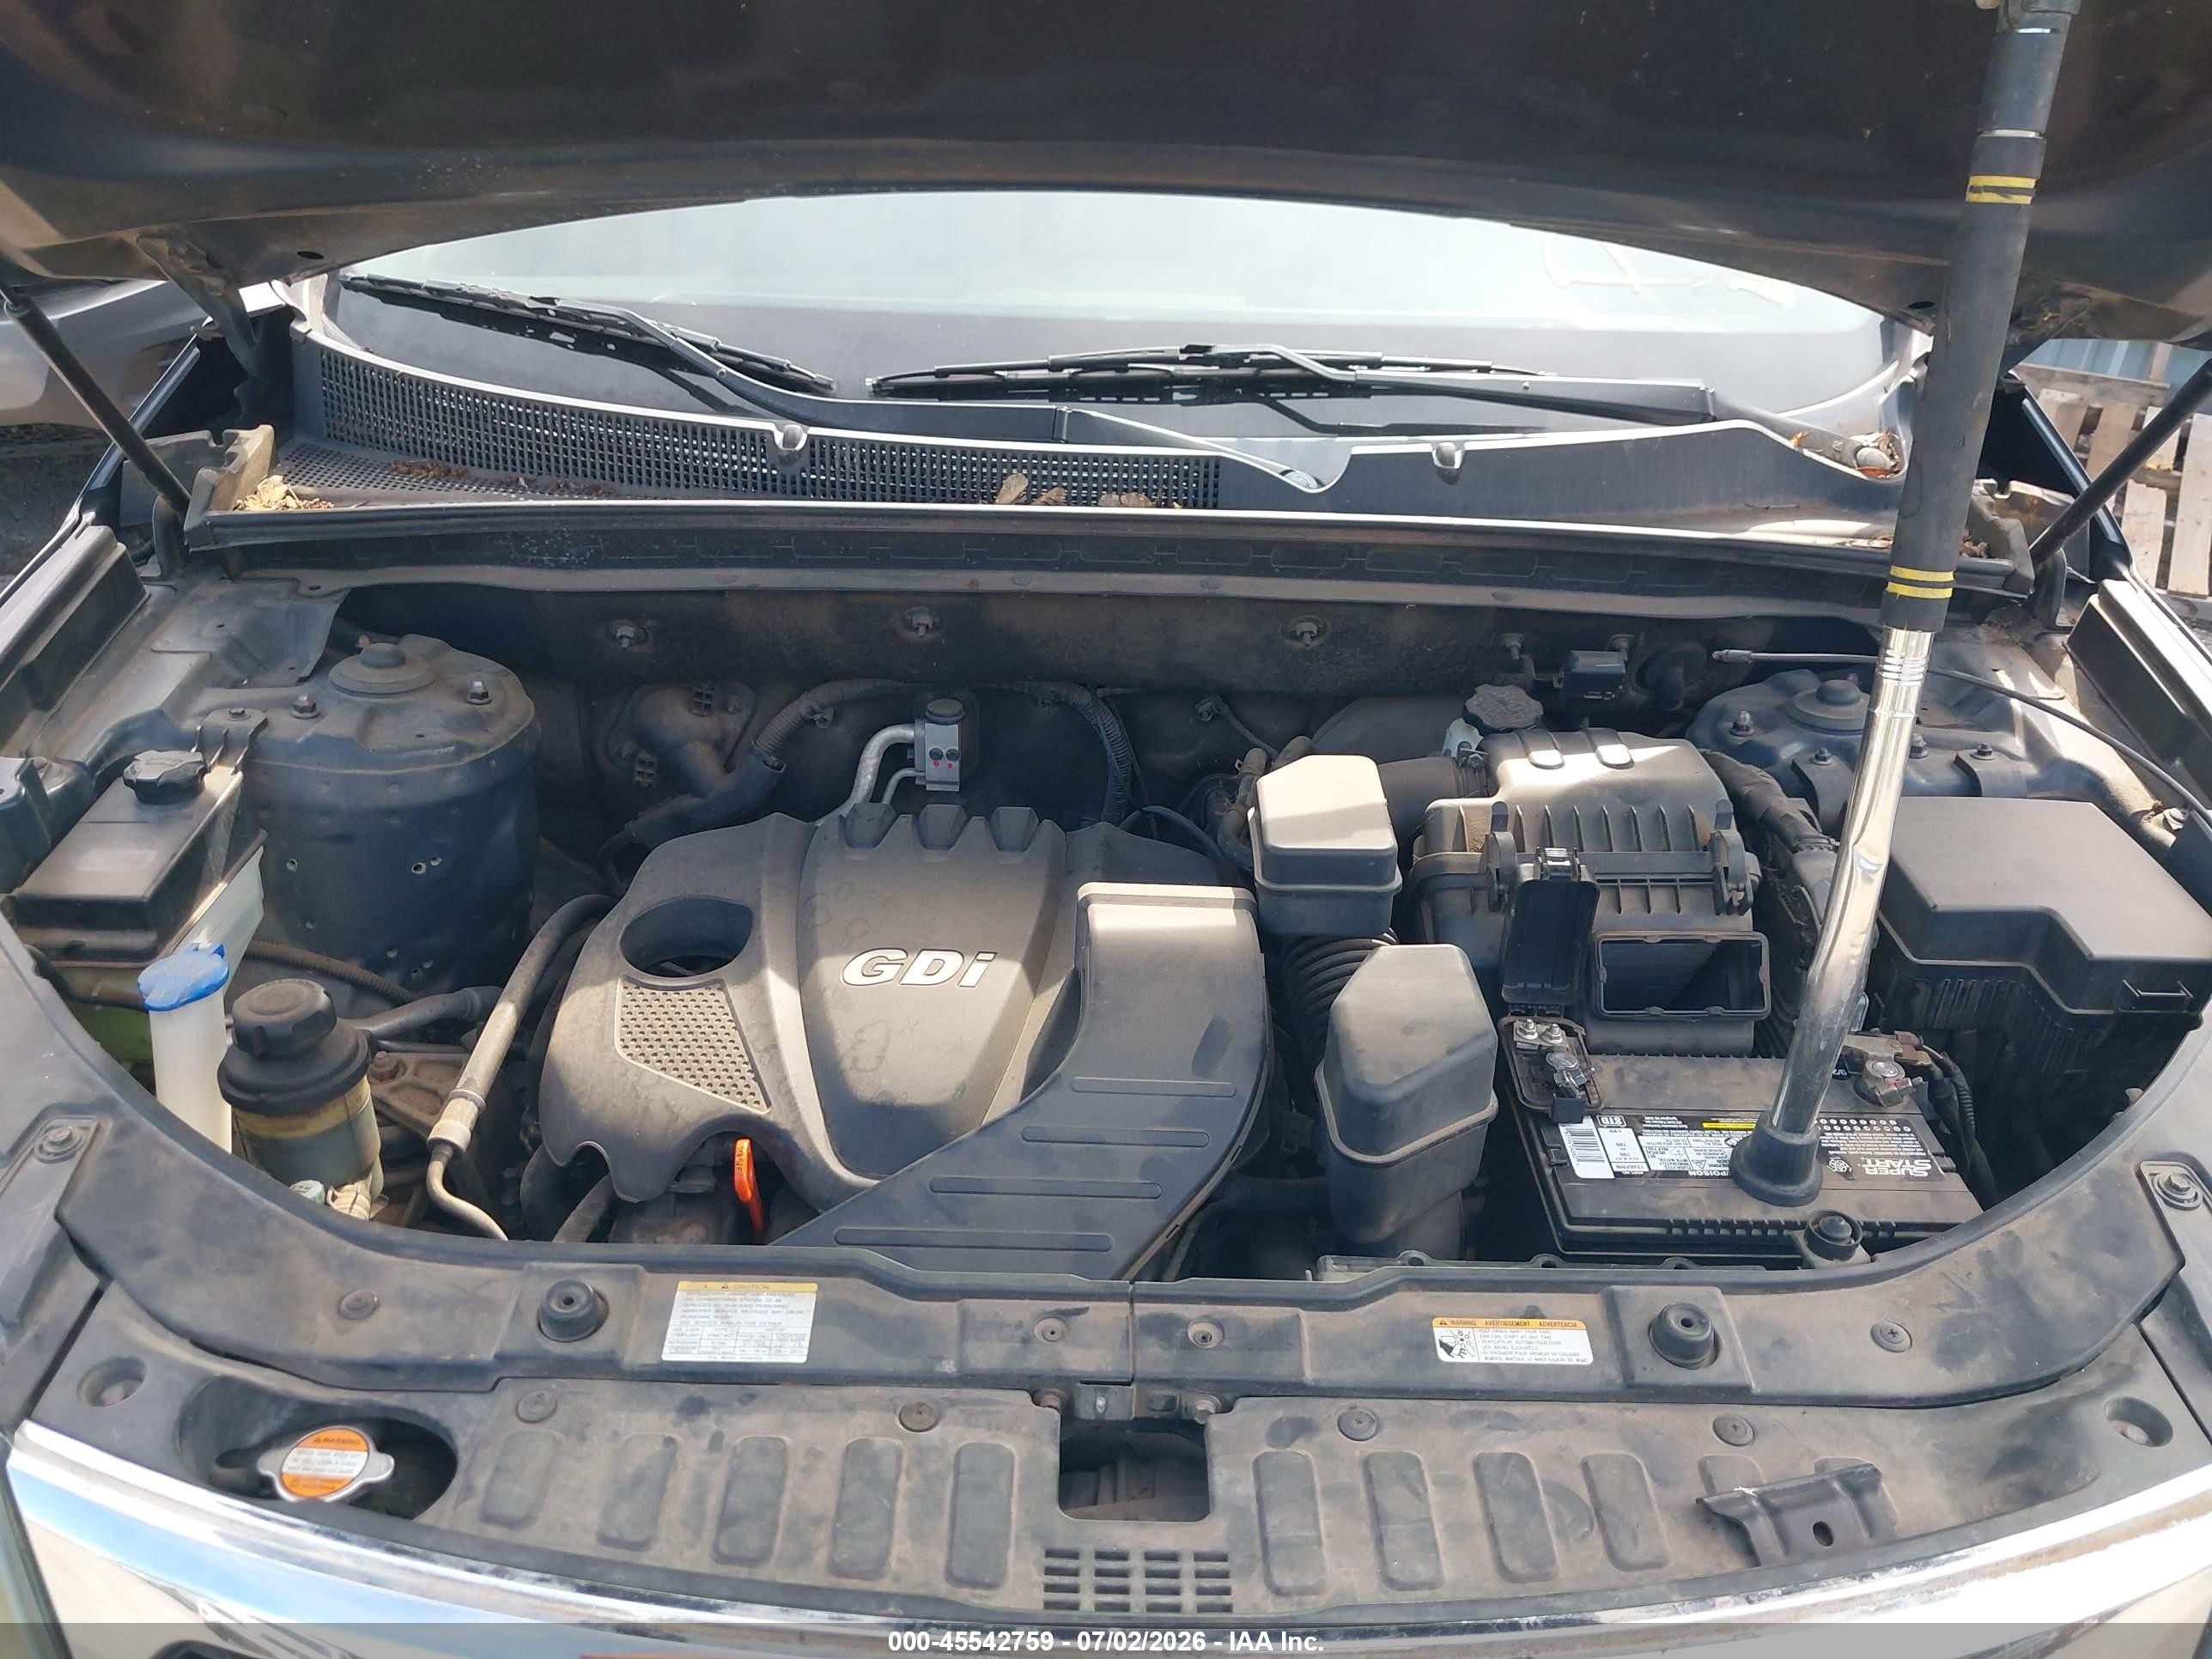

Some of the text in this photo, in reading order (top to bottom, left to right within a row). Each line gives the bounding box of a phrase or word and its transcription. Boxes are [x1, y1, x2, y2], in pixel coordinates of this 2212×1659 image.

[841, 947, 998, 988] GDi
[1862, 1159, 1932, 1170] START
[1864, 1167, 1929, 1177] SUPER
